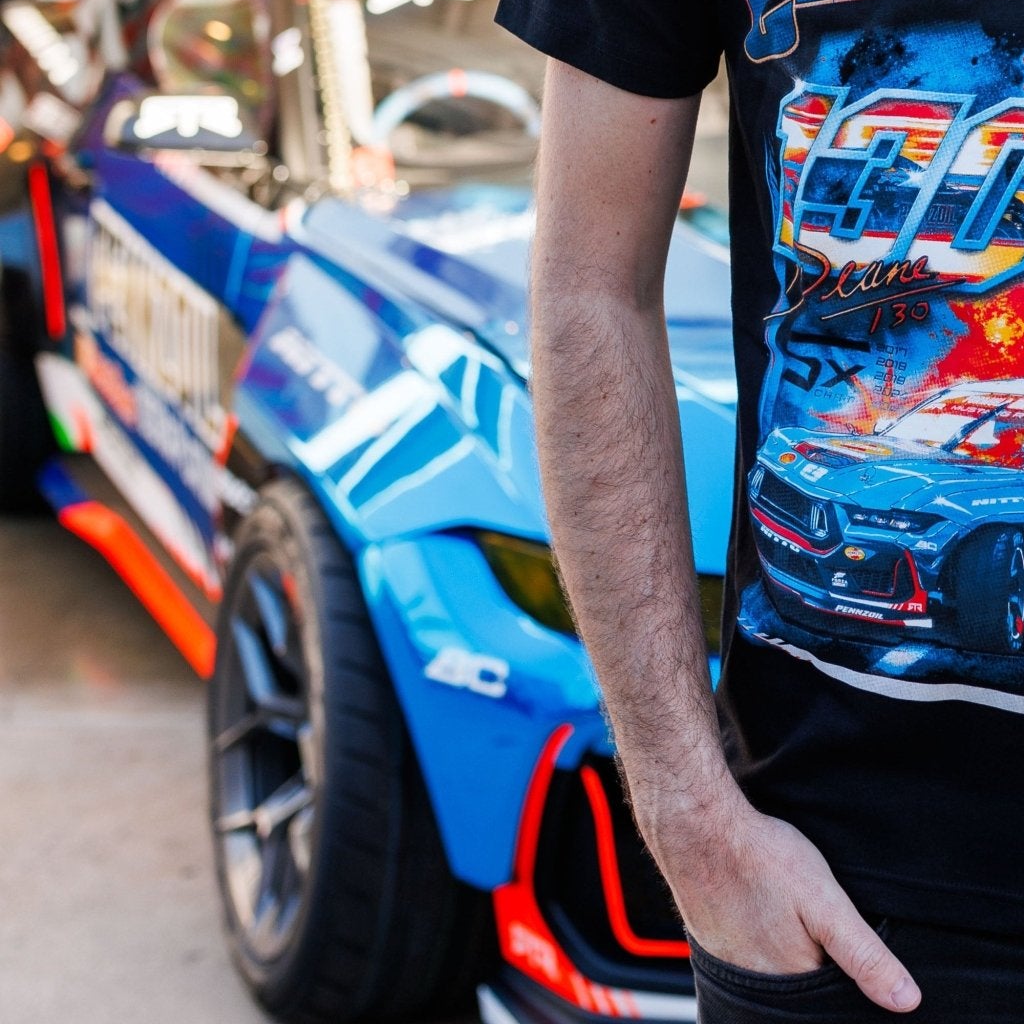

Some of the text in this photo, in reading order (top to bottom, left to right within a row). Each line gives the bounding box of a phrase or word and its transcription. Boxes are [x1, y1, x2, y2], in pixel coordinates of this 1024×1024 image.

[869, 301, 930, 335] 130
[876, 358, 907, 371] 2018
[835, 604, 884, 620] PENNZOIL
